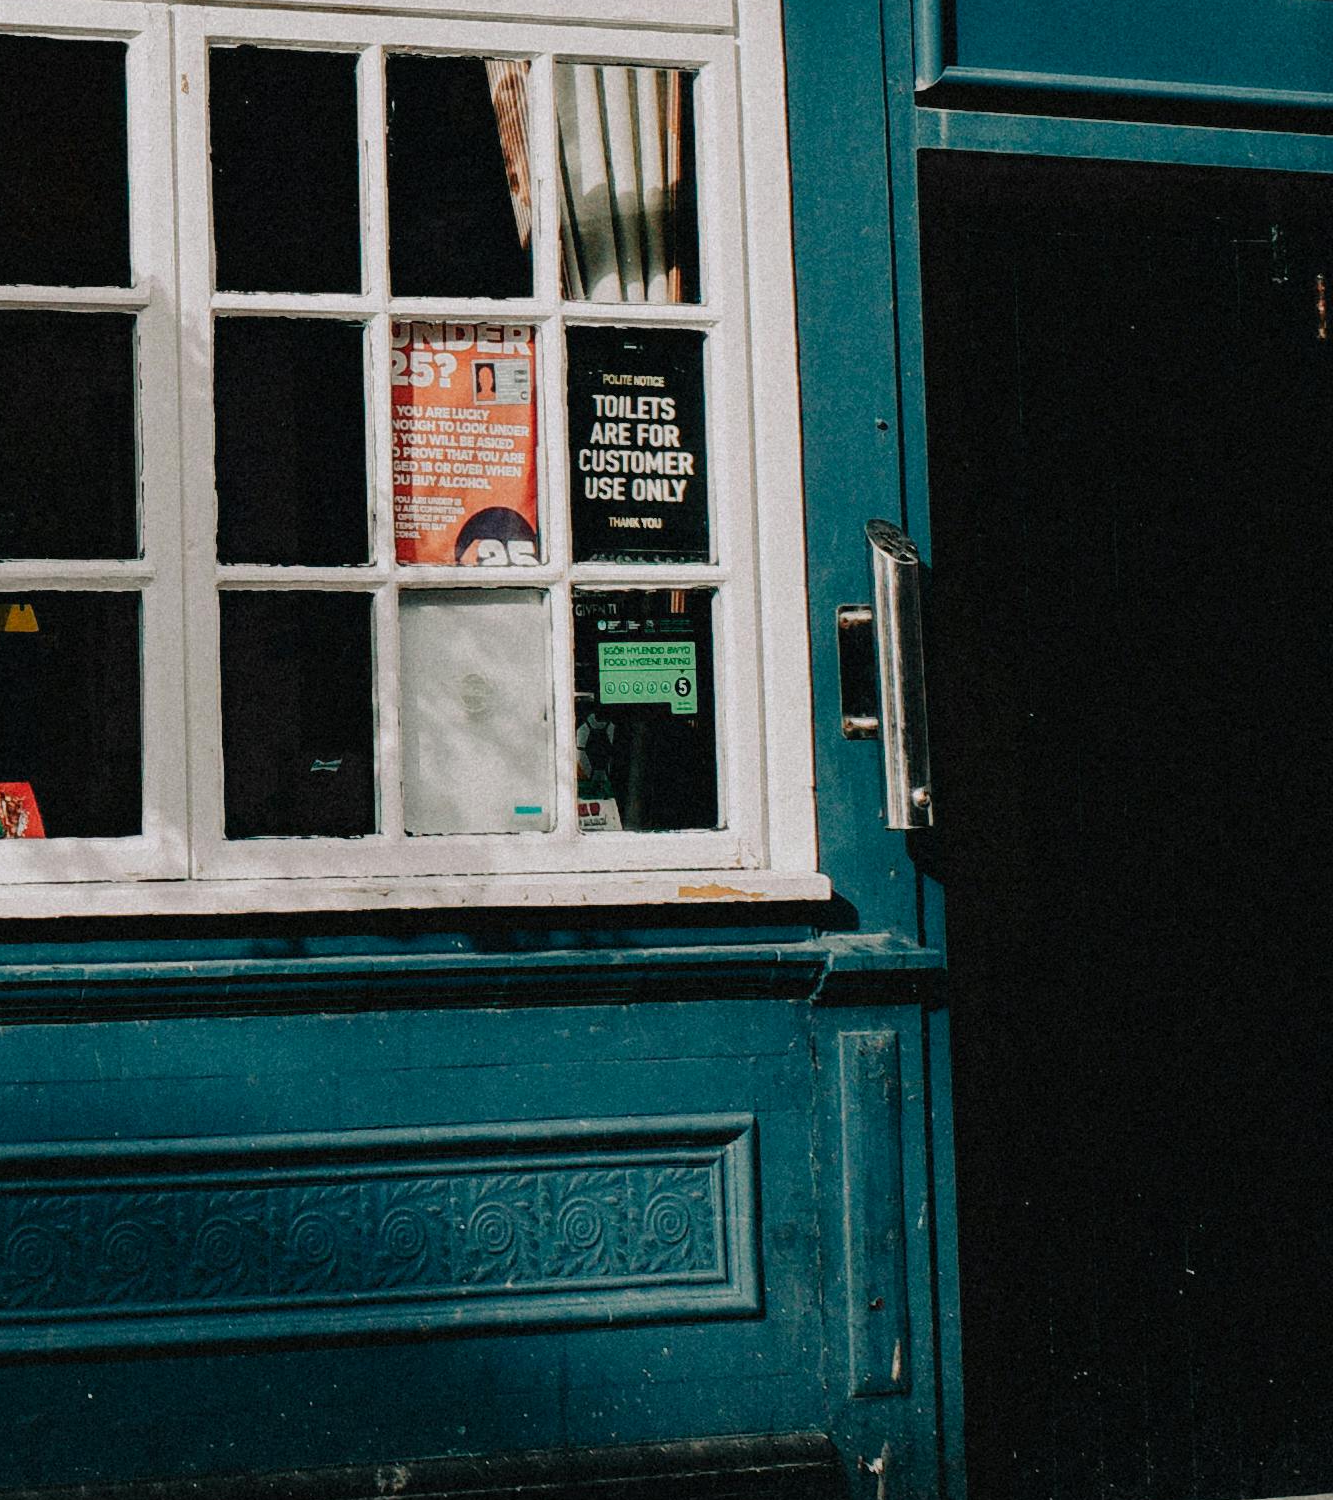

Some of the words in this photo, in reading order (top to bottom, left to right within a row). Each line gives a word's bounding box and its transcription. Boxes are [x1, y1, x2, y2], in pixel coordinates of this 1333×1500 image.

[392, 321, 531, 355] UNDER
[392, 351, 457, 388] 25?
[602, 374, 632, 386] POLITE
[633, 376, 665, 387] NOTICE
[397, 405, 423, 417] YOU
[425, 407, 450, 418] ARE
[453, 408, 490, 420] LUCKY
[592, 394, 676, 421] TOILETS
[438, 421, 454, 432] TO
[456, 422, 487, 433] LOOK
[489, 424, 529, 437] UNDER
[590, 422, 631, 445] ARE
[636, 424, 680, 447] FOR
[400, 433, 426, 444] YOU
[429, 434, 458, 446] WILL
[459, 436, 474, 446] BE
[476, 437, 514, 449] ASKED
[403, 447, 443, 459] PROVE
[446, 449, 474, 460] THAT
[476, 450, 499, 462] YOU
[501, 452, 525, 464] ARE
[579, 449, 694, 476] CUSTOMER
[435, 463, 451, 473] OR
[453, 463, 483, 474] OVER
[485, 465, 522, 477] WHEN
[412, 475, 436, 486] BUY
[584, 477, 626, 500] USE
[631, 478, 687, 502] ONLY
[608, 516, 639, 528] THANK
[640, 517, 663, 529] YOU
[604, 658, 627, 666] FOOD
[629, 658, 662, 666] HYGIENE
[664, 657, 691, 666] RATING
[679, 679, 688, 695] 5
